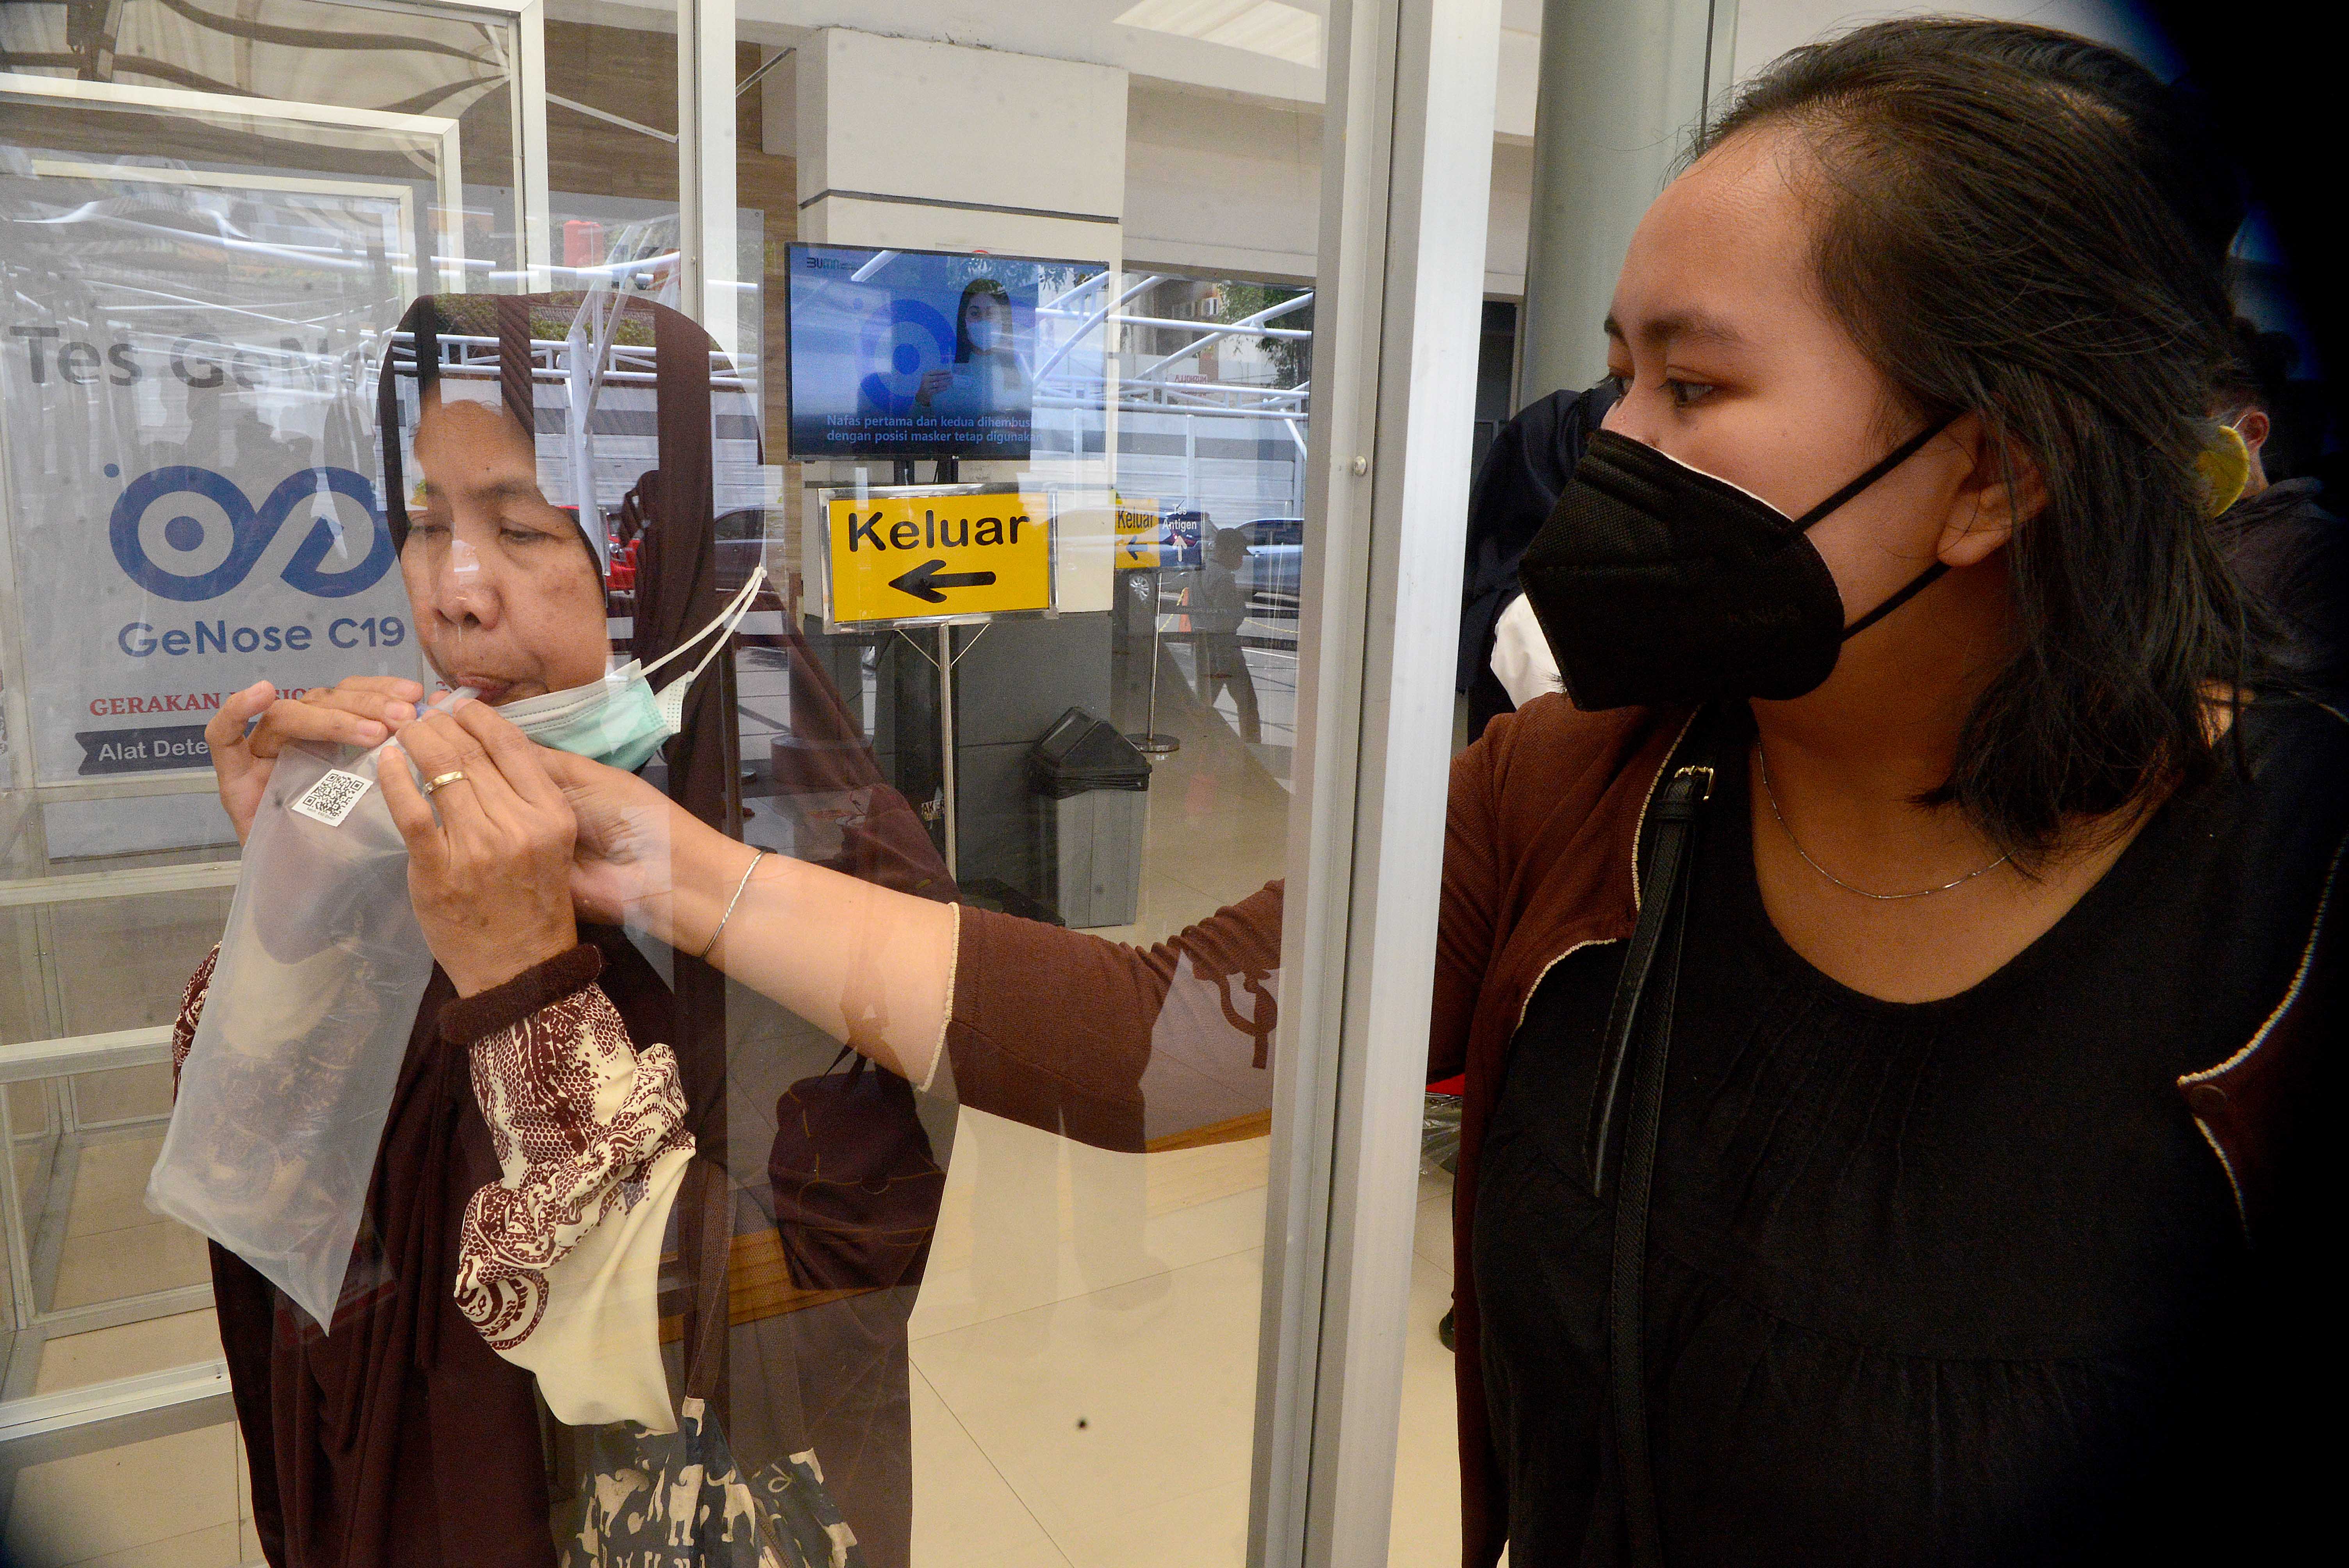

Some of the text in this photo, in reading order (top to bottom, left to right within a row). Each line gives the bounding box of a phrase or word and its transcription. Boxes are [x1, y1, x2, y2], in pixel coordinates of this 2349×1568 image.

[9, 326, 142, 386] Tes
[827, 415, 860, 426] Nafas
[864, 416, 913, 428] pertama
[916, 415, 937, 426] dan
[941, 416, 974, 427] kedua
[827, 430, 1042, 444] dengan posisi masker tetap digunakan
[1118, 506, 1153, 529] Keluar
[1173, 504, 1187, 515] Tes
[848, 510, 1030, 552] Keluar
[1162, 519, 1197, 533] Antigen
[118, 617, 405, 657] GeNose C19
[90, 693, 220, 716] GERAKAN
[99, 739, 209, 761] Alat Dete
